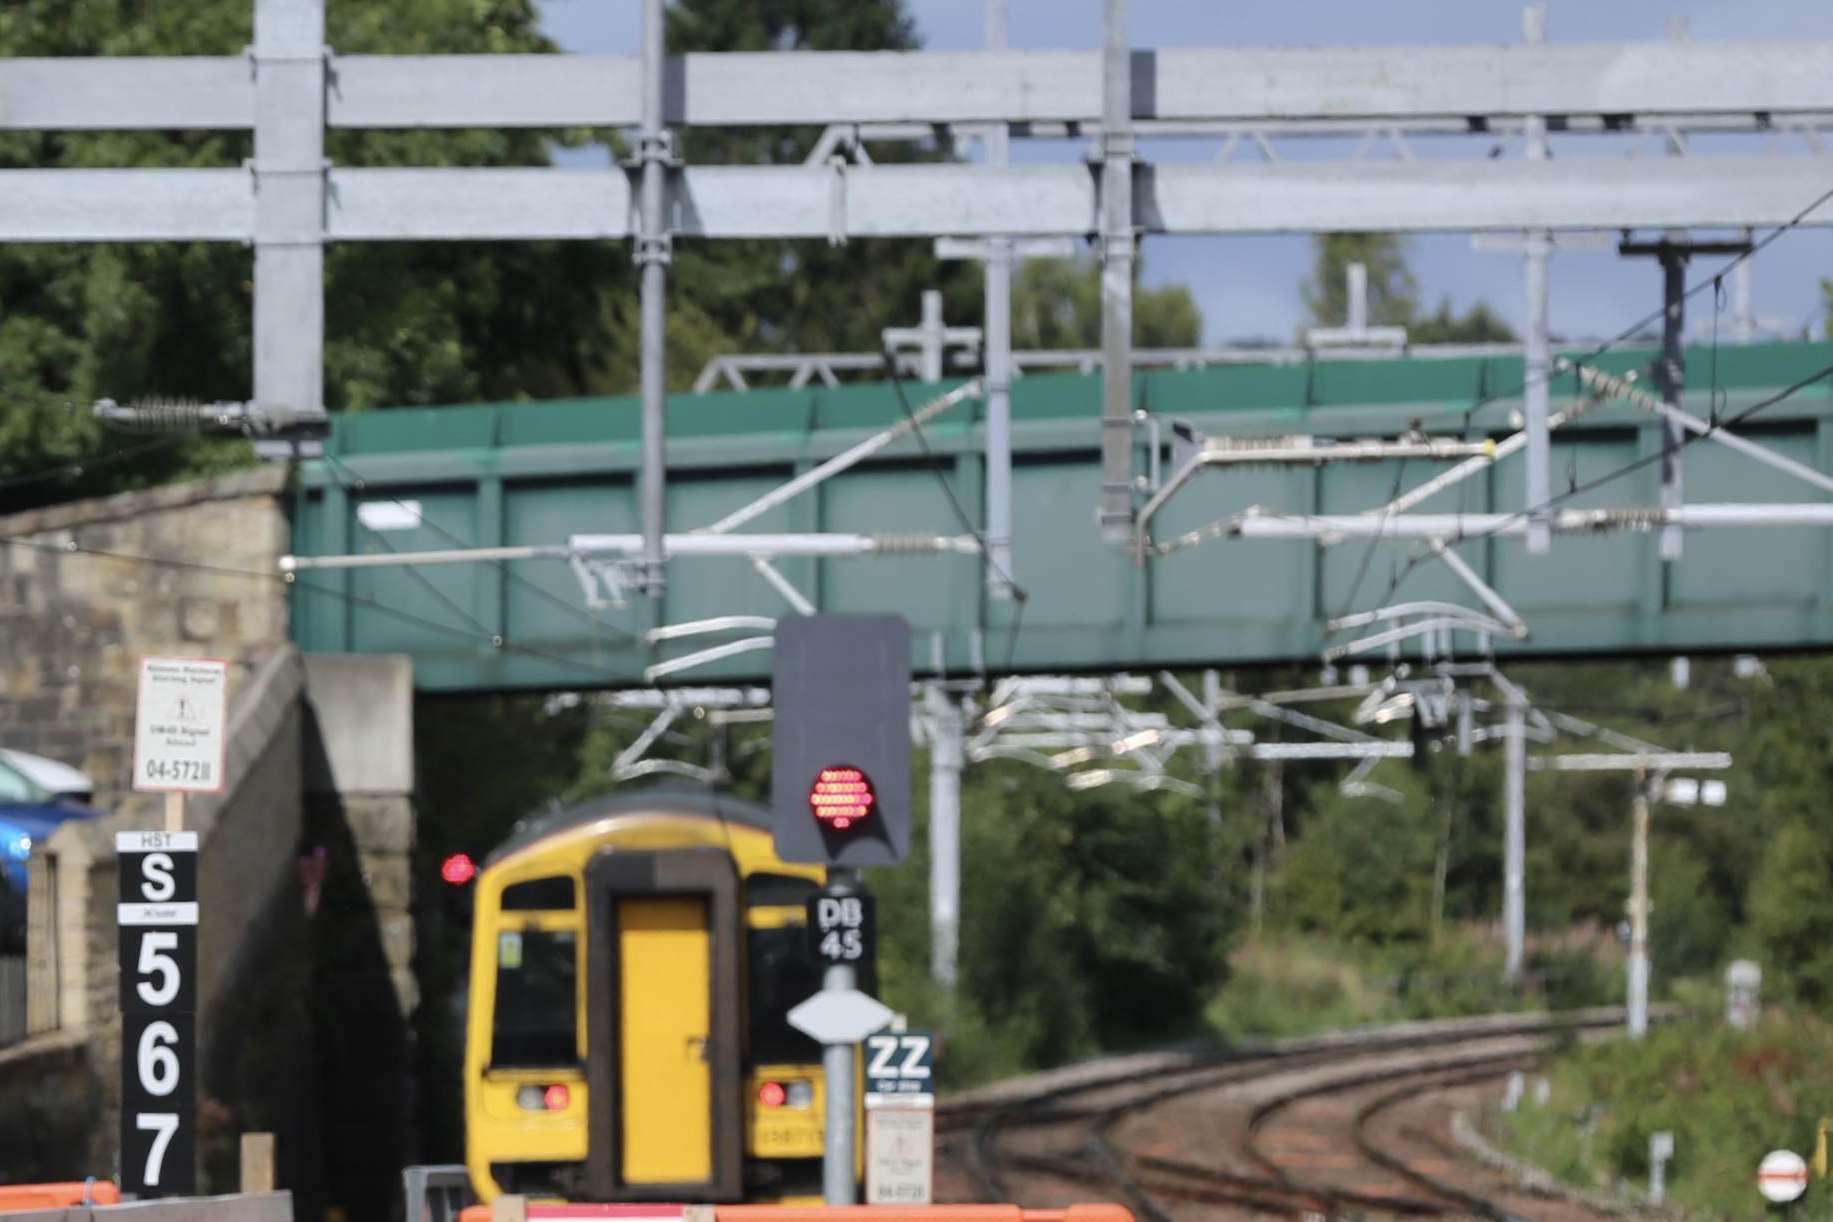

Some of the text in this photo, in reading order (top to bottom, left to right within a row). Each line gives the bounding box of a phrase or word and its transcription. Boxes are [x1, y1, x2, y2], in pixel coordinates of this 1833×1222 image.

[140, 852, 176, 902] S
[141, 832, 172, 848] HST
[136, 932, 181, 1006] 5
[137, 1020, 181, 1097] 6
[136, 1112, 180, 1186] 7
